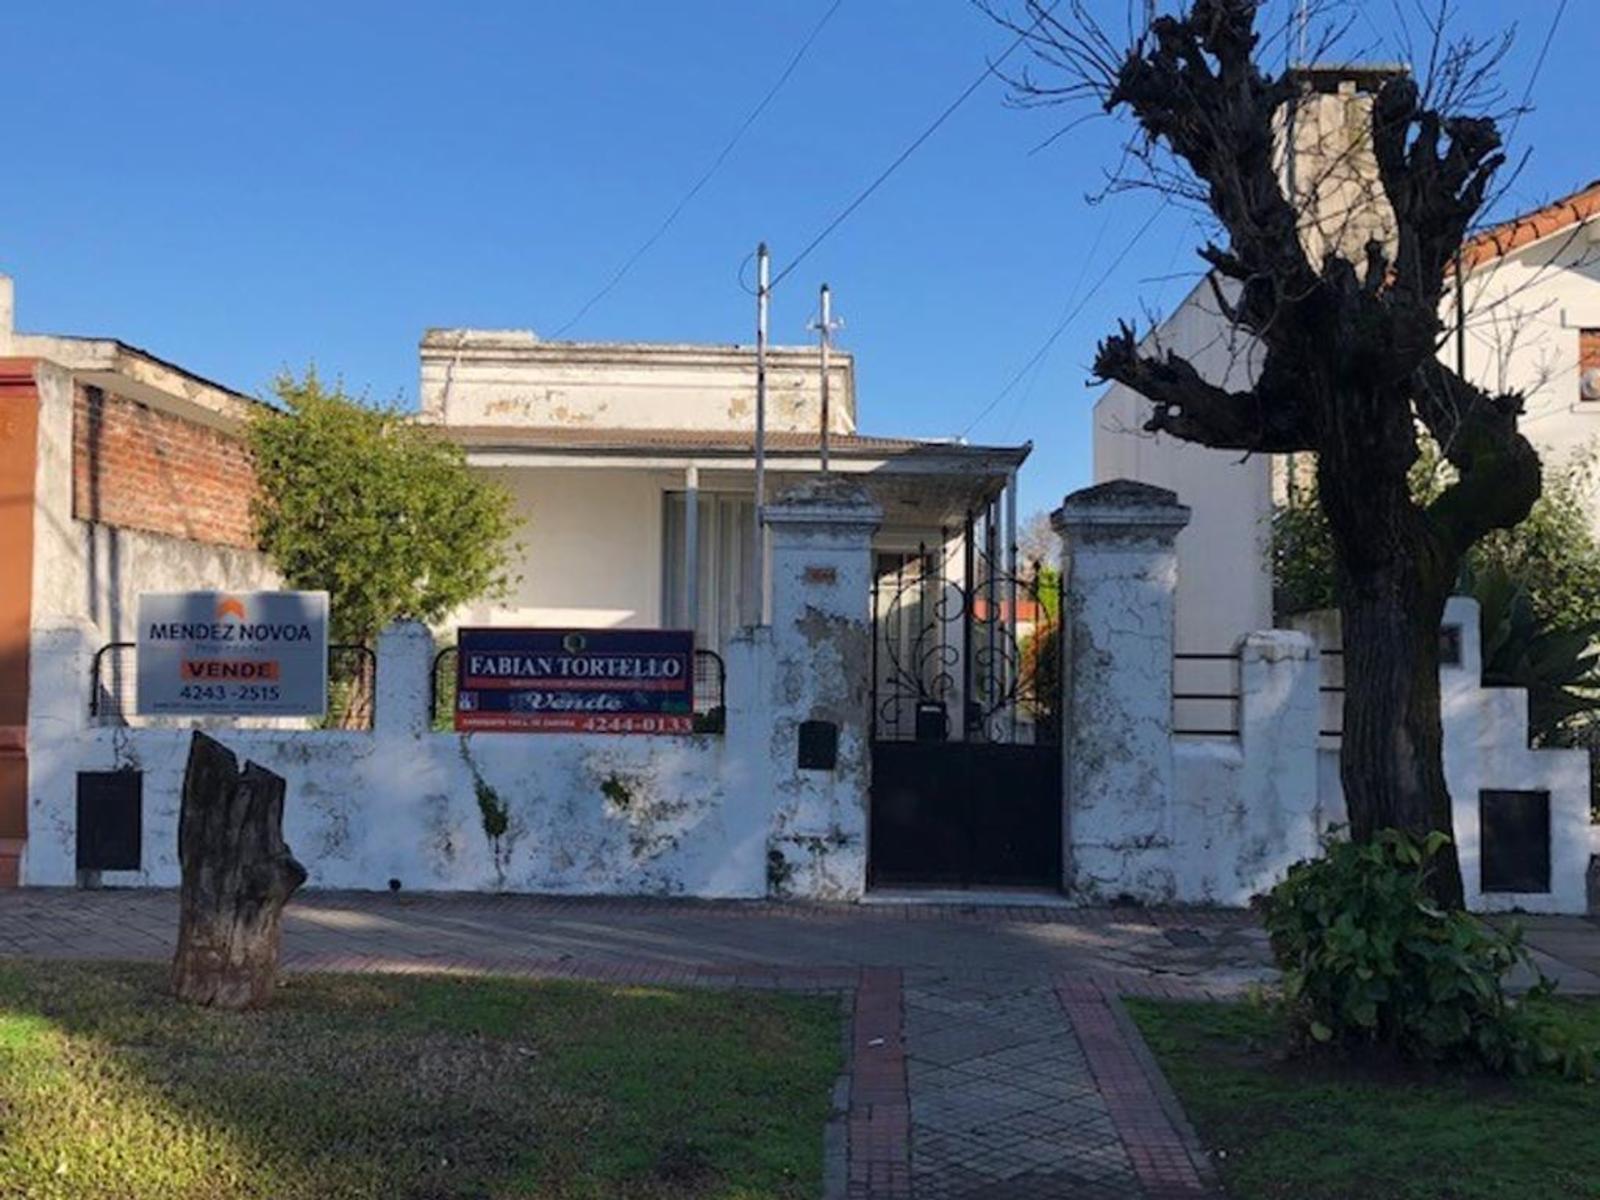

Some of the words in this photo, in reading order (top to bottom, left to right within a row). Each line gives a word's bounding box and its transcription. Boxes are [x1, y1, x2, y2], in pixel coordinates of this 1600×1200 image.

[150, 623, 234, 641] MENDEZ
[239, 624, 311, 642] NOVOA
[188, 662, 272, 679] VENDE
[470, 656, 551, 675] FABIAN
[557, 657, 680, 677] TORTELLO
[525, 691, 622, 710] Vende
